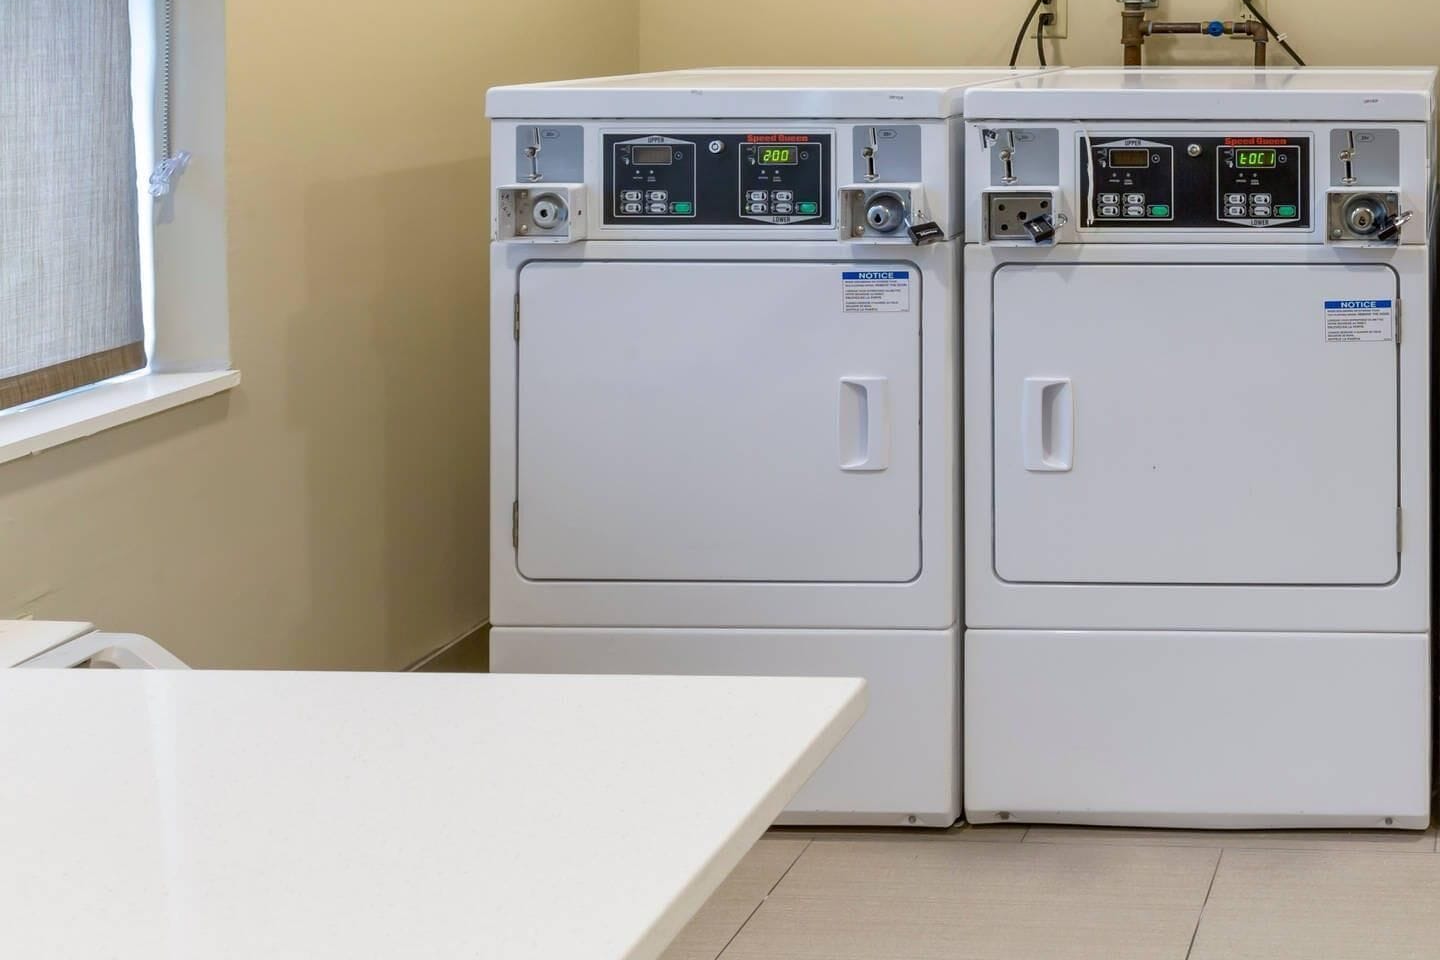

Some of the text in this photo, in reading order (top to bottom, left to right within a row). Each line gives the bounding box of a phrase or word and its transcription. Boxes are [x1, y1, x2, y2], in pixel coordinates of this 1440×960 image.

[747, 135, 777, 143] Speed
[1225, 137, 1287, 146] Speed Queen
[763, 149, 790, 162] 200
